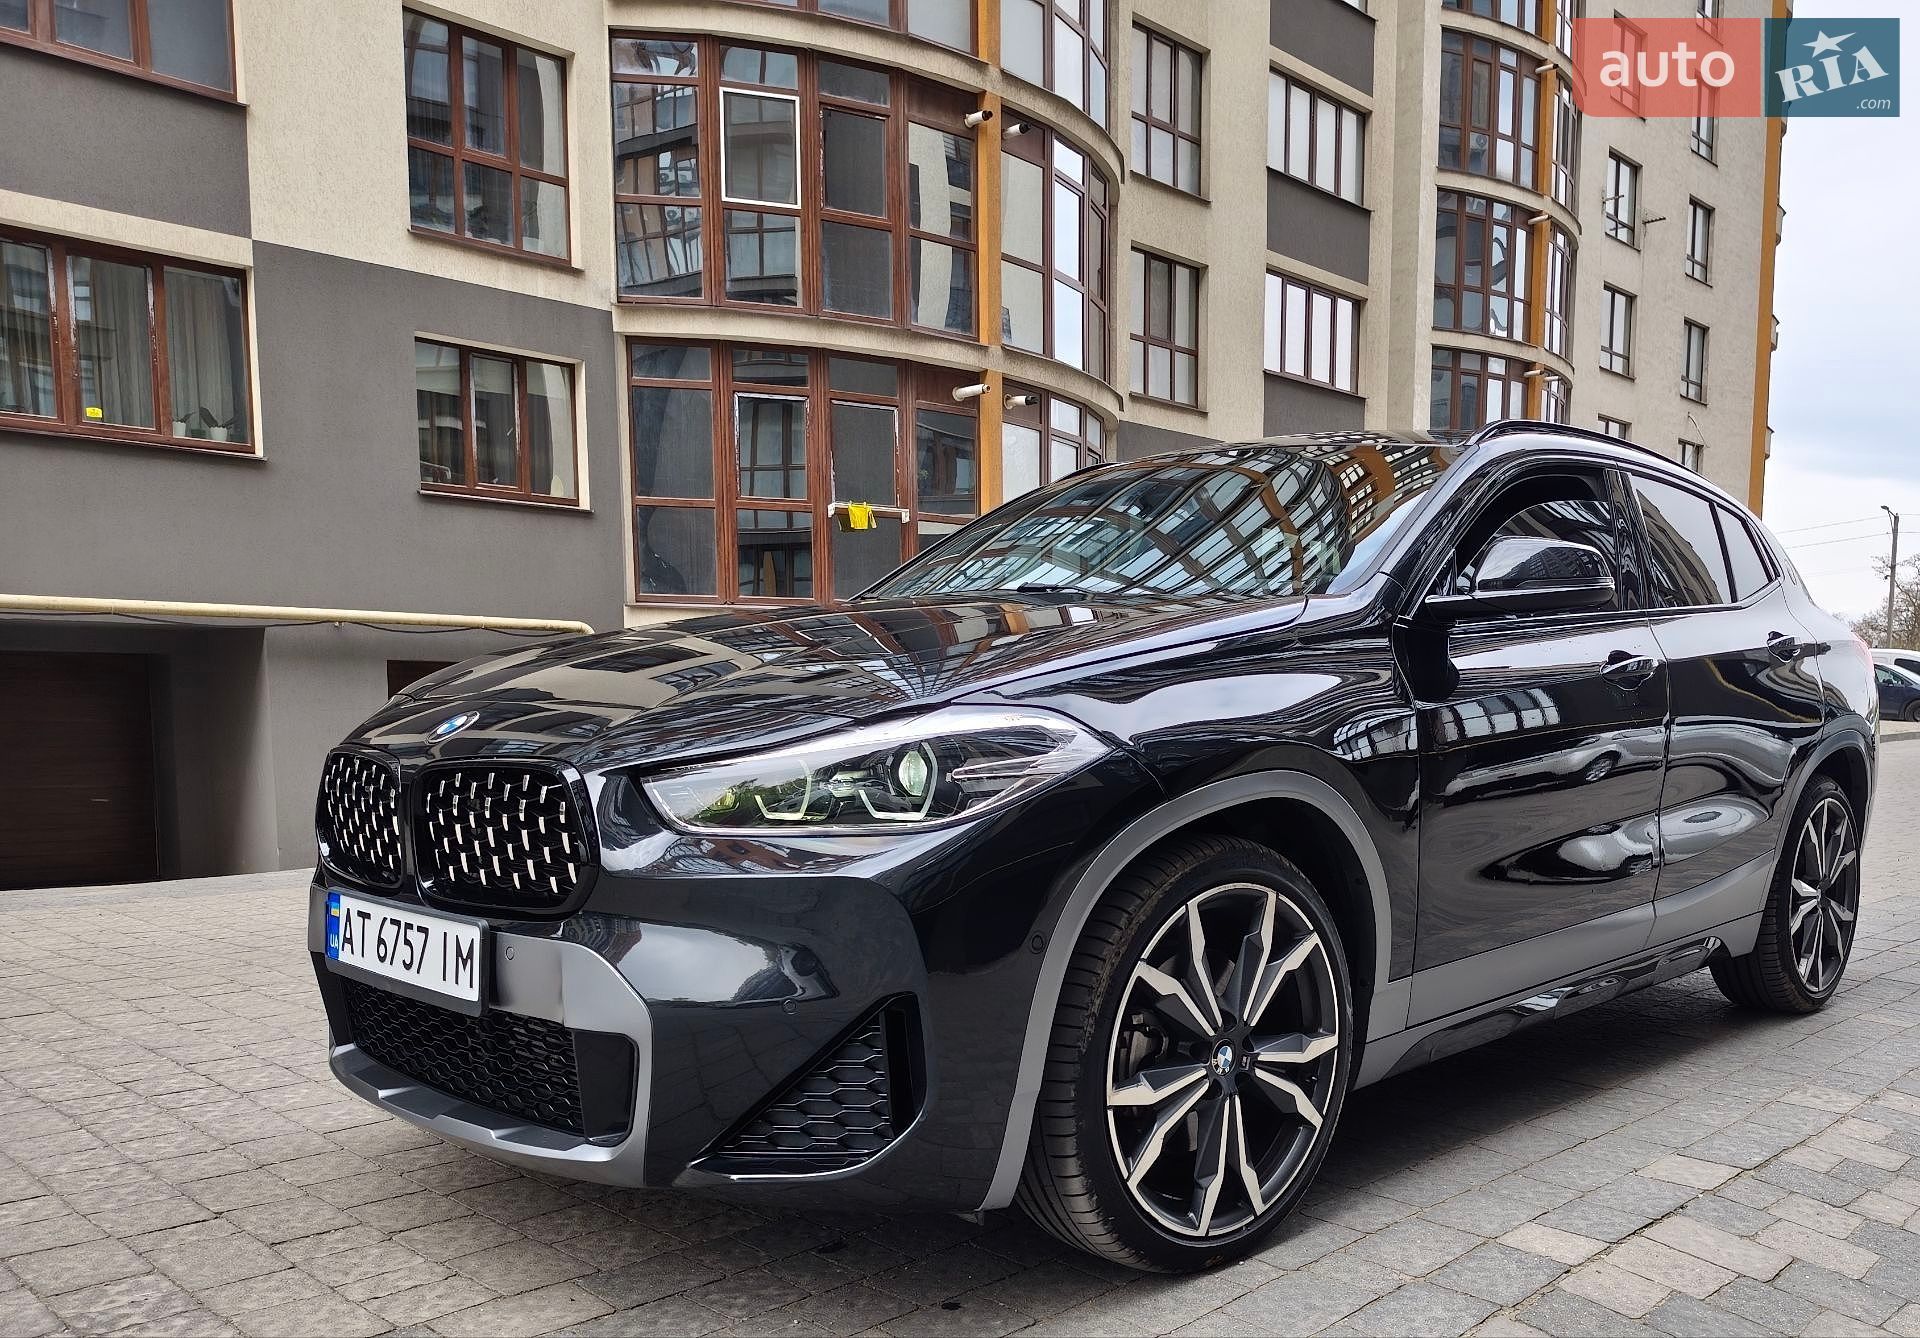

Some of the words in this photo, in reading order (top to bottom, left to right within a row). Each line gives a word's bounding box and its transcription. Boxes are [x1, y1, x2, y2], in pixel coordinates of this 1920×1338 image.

[329, 933, 339, 950] UA
[341, 907, 371, 958] AT
[376, 916, 429, 974] 6757
[442, 931, 474, 988] IM
